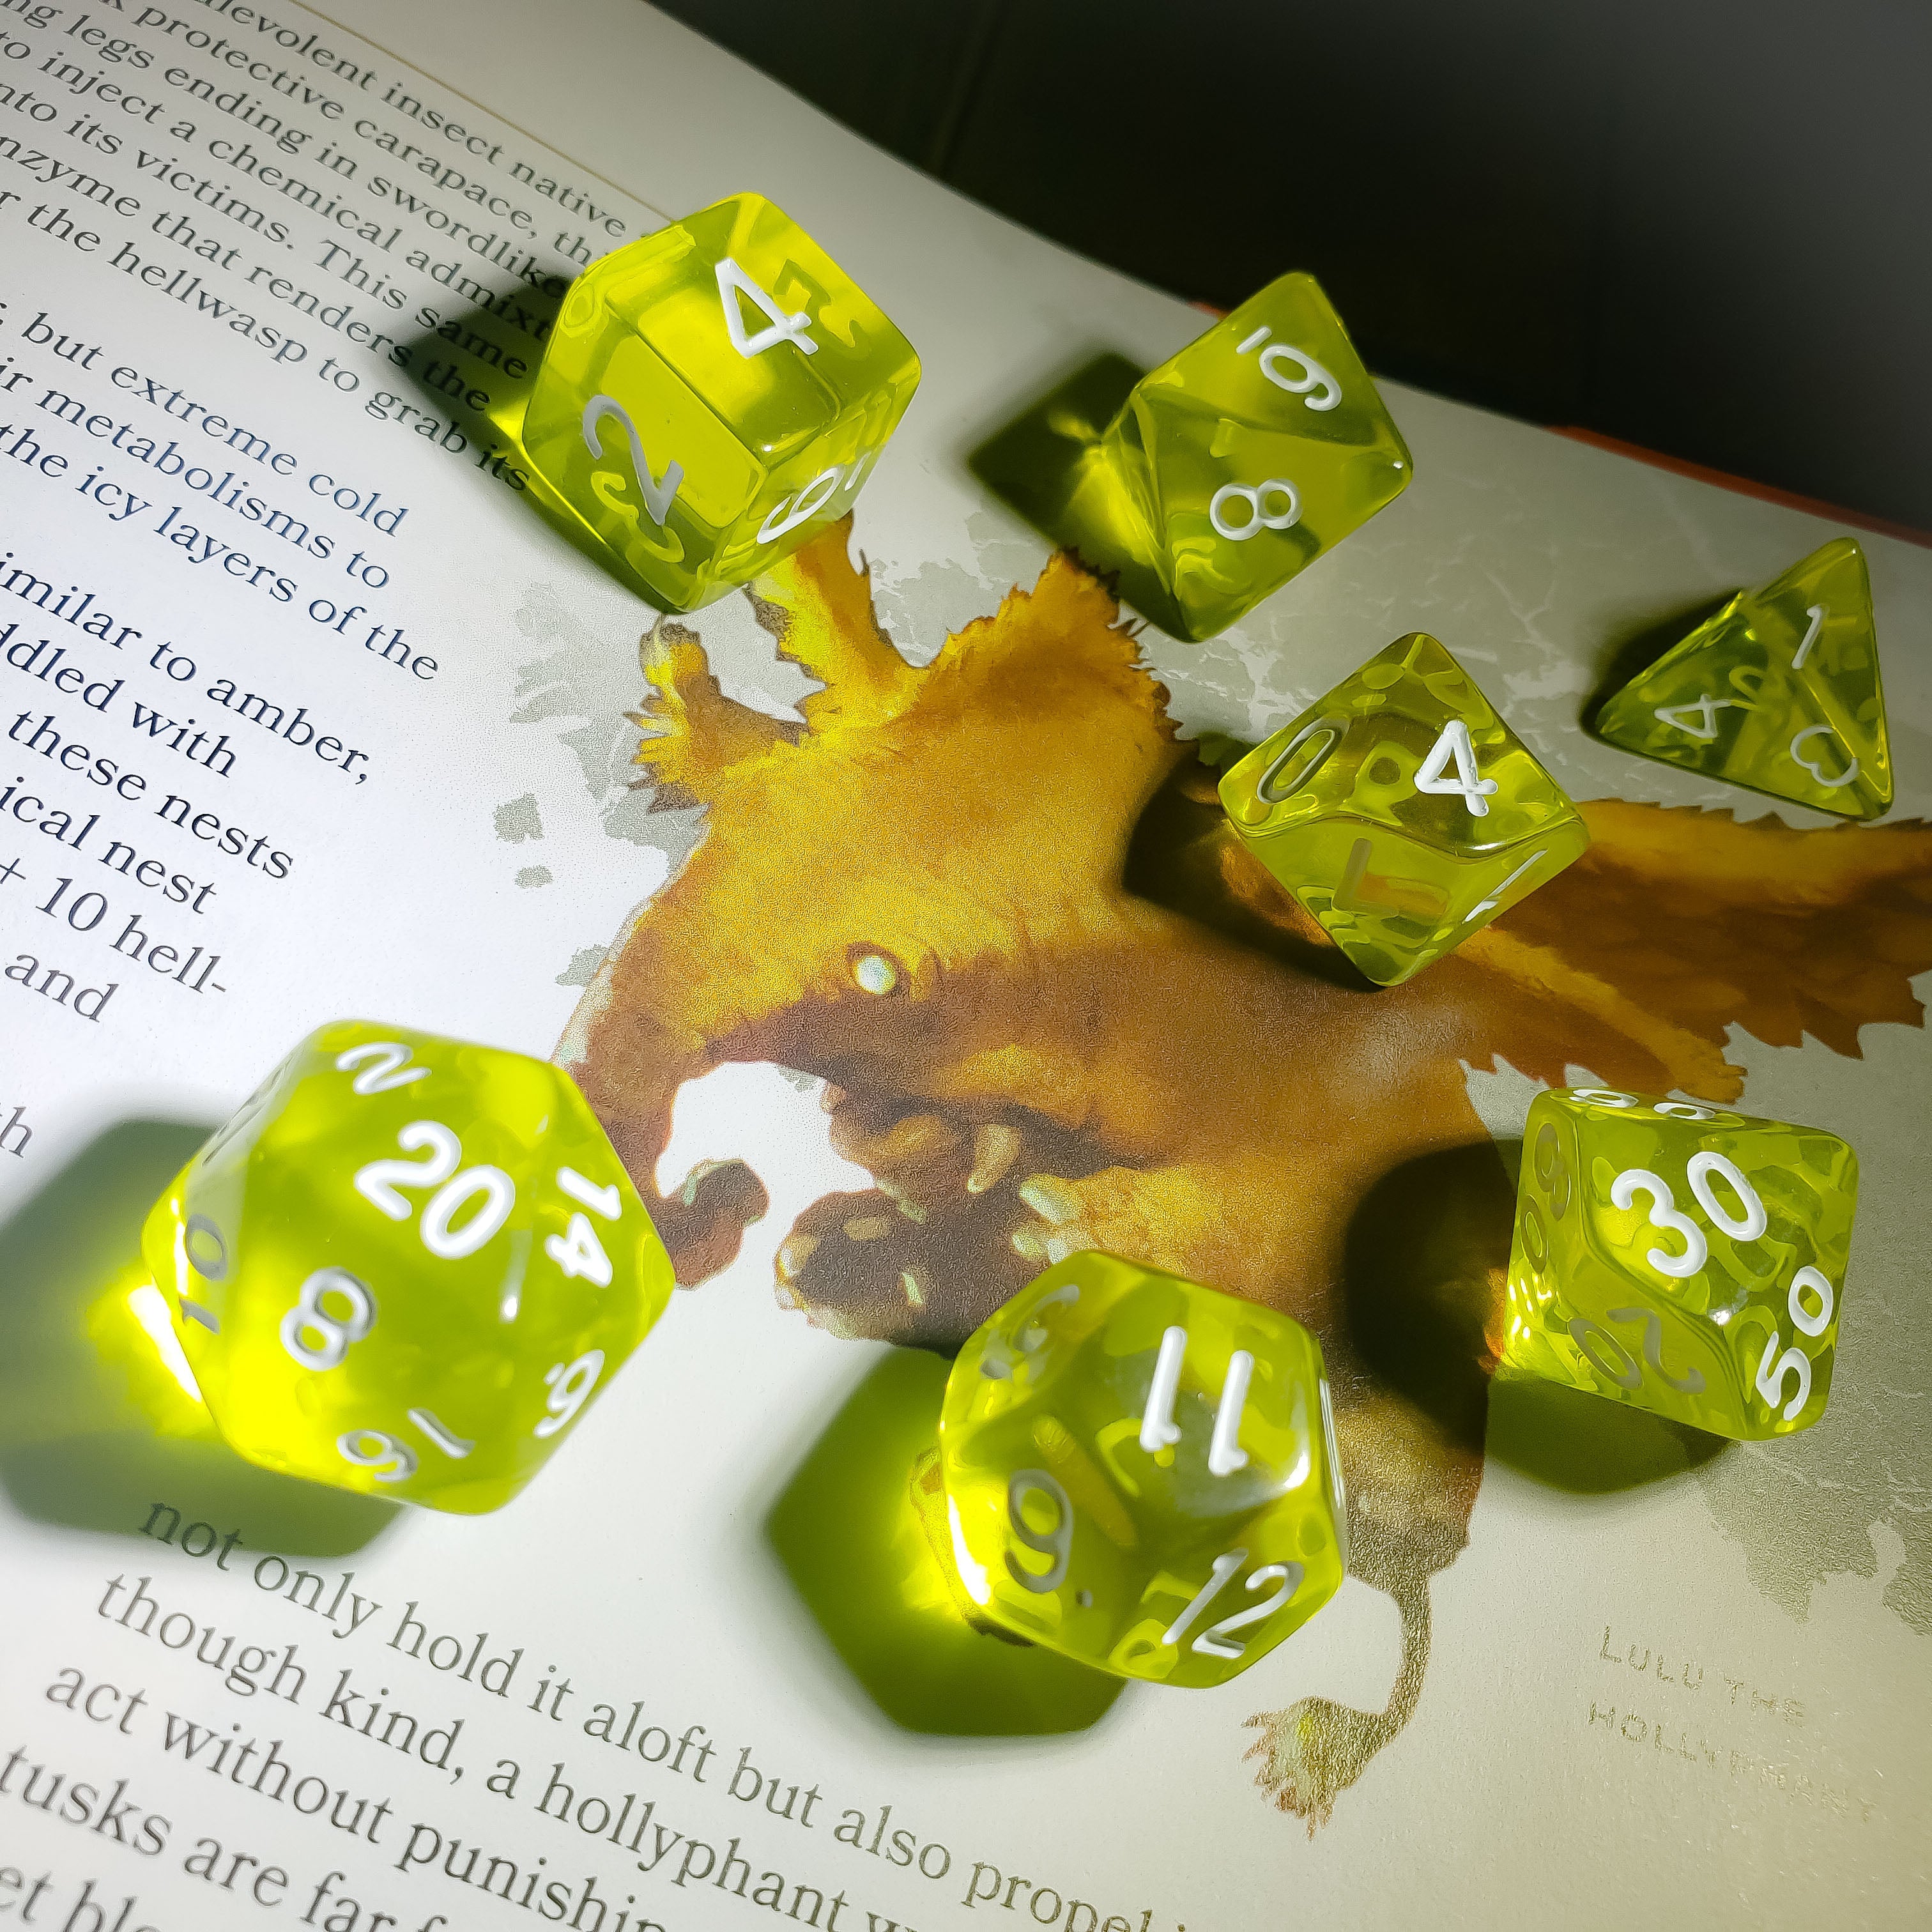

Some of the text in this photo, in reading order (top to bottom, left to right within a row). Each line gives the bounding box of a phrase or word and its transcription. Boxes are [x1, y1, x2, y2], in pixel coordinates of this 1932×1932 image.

[37, 52, 165, 125] inject
[170, 121, 197, 143] a
[209, 139, 402, 253] chemical
[63, 15, 155, 68] legs
[164, 67, 312, 155] ending
[314, 142, 358, 181] in
[131, 7, 594, 268] protective carapace, th
[197, 0, 627, 238] evolent insect native
[63, 114, 123, 155] its
[135, 149, 294, 250] victims.
[313, 240, 408, 310] This
[415, 307, 528, 379] same
[151, 211, 243, 270] that
[244, 266, 413, 369] renders
[423, 360, 491, 412] the
[714, 257, 820, 360] 4
[27, 204, 101, 252] the
[107, 242, 308, 364] hellwasp
[319, 356, 360, 393] to
[365, 391, 468, 454] grab
[475, 444, 530, 491] its
[21, 311, 409, 538] but extreme cold
[35, 390, 335, 559] metabolisms
[346, 551, 390, 588] to
[581, 394, 684, 526] 2
[0, 424, 438, 680] the icy layers of the
[1209, 477, 1303, 542] 8
[1791, 603, 1829, 670] 1
[131, 702, 238, 778] with
[149, 641, 197, 682] to
[206, 678, 369, 785] amber,
[1256, 716, 1351, 805] 0
[1413, 719, 1499, 817] 4
[1653, 693, 1732, 739] 4
[7, 710, 293, 880] these nests
[36, 877, 108, 931] 10
[109, 914, 226, 994] hell-
[98, 840, 217, 914] nest
[4, 953, 119, 1023] and
[335, 1041, 432, 1095] 2
[353, 1119, 516, 1261] 20
[542, 1165, 624, 1290] 14
[1610, 1151, 1767, 1278] 30
[279, 1266, 378, 1372] 8
[1755, 1265, 1834, 1422] 50
[1138, 1325, 1255, 1477] 11
[1161, 1547, 1305, 1660] 12
[138, 1502, 245, 1572] not
[254, 1556, 383, 1639] only
[386, 1601, 525, 1698] hold
[527, 1664, 574, 1722] it
[583, 1700, 717, 1783] aloft
[726, 1747, 823, 1828] but
[834, 1805, 952, 1880] also
[1599, 1625, 1807, 1728] LULU THE
[45, 1666, 149, 1735] act
[164, 1710, 394, 1844] without
[96, 1574, 850, 1932] though kind, a hollyphant
[0, 1745, 173, 1855] tusks
[183, 1837, 289, 1906] are
[61, 1879, 161, 1932] bl
